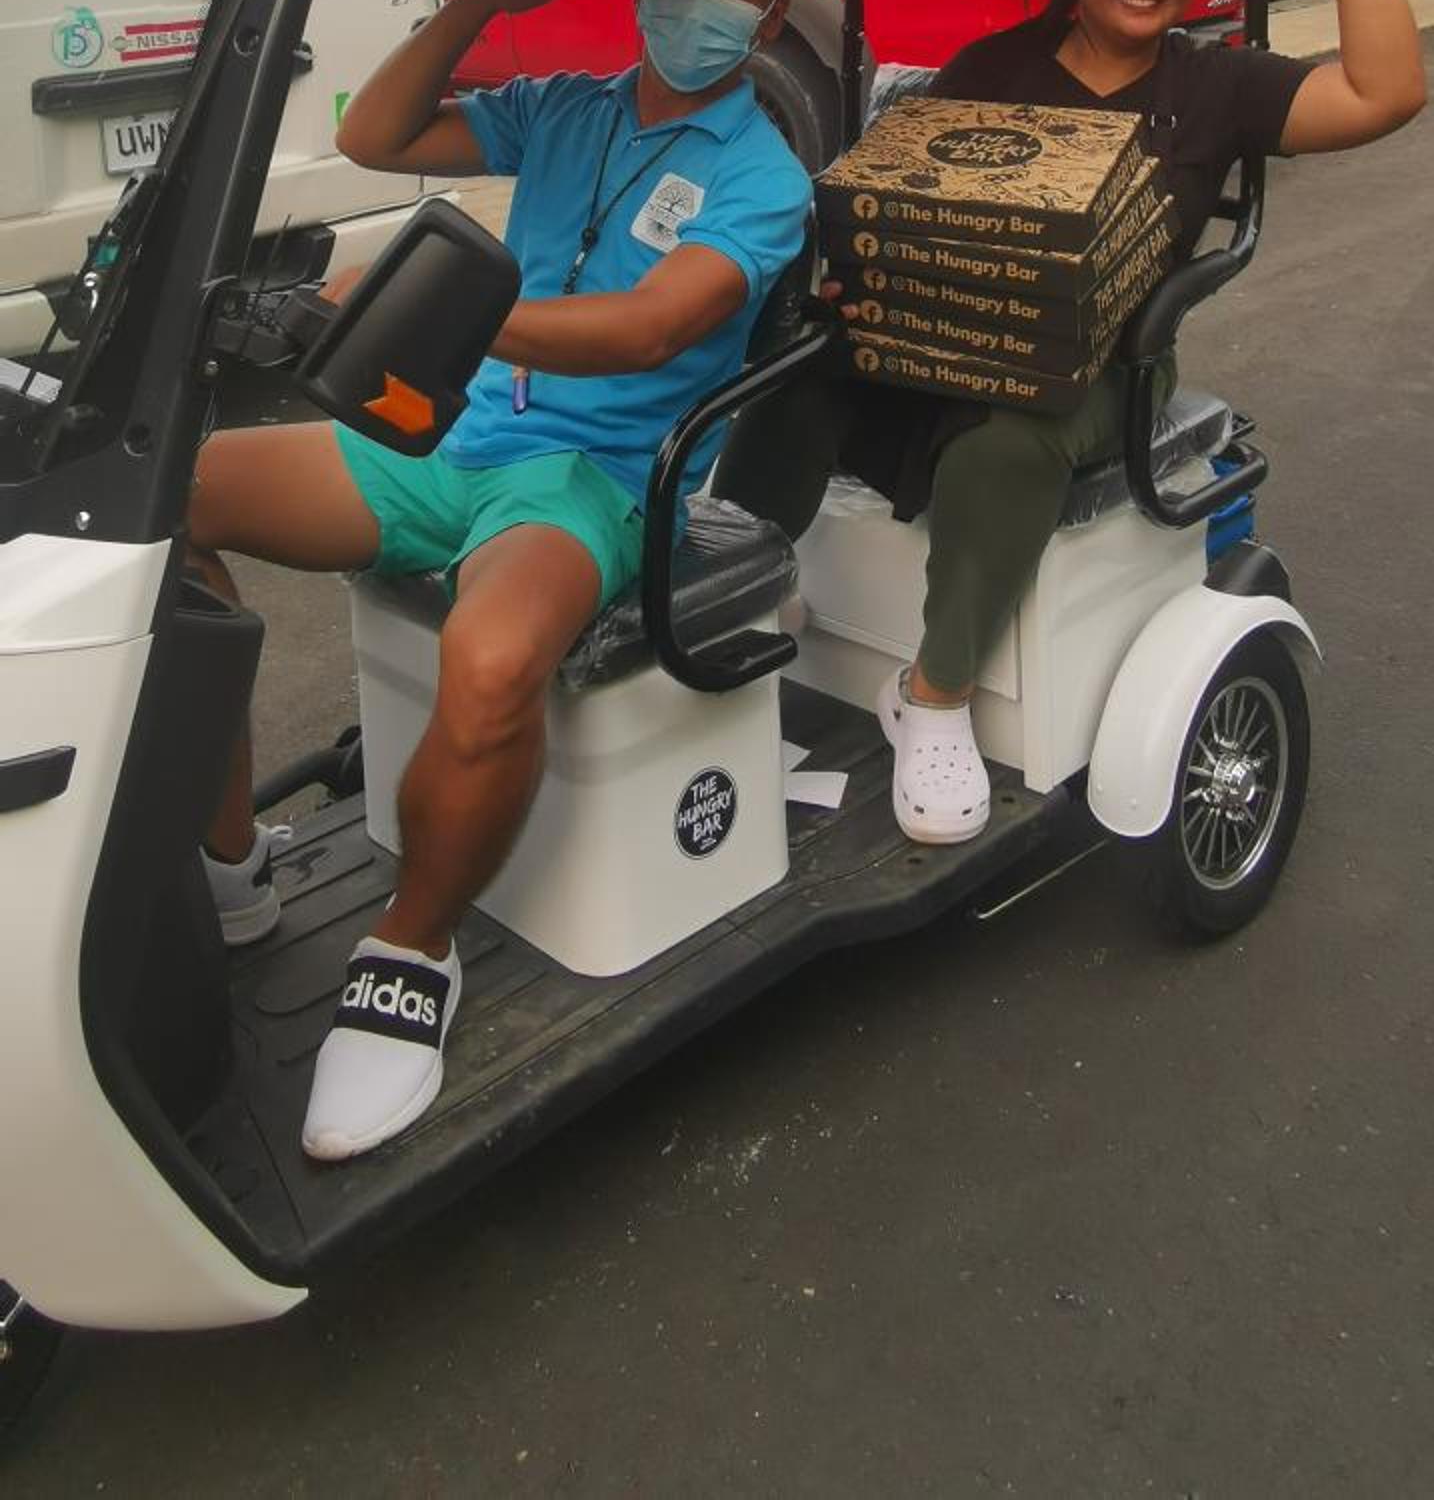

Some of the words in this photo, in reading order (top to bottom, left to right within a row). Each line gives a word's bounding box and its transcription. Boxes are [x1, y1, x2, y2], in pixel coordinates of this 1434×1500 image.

[883, 201, 932, 222] @The
[937, 207, 1004, 233] Hungry
[1009, 216, 1046, 235] Bar
[883, 241, 930, 263] @The
[935, 250, 1001, 277] Hungry
[1005, 261, 1041, 281] Bar
[941, 285, 1004, 315] Hungry
[1008, 299, 1041, 320] Bar
[937, 319, 999, 349] Hungry
[1003, 334, 1036, 354] Bar
[935, 364, 1000, 393] Hungry
[1005, 377, 1039, 397] Bar
[690, 775, 717, 804] THE
[678, 786, 733, 829] HUNGRY
[693, 813, 723, 842] BAR
[343, 972, 437, 1027] didas
